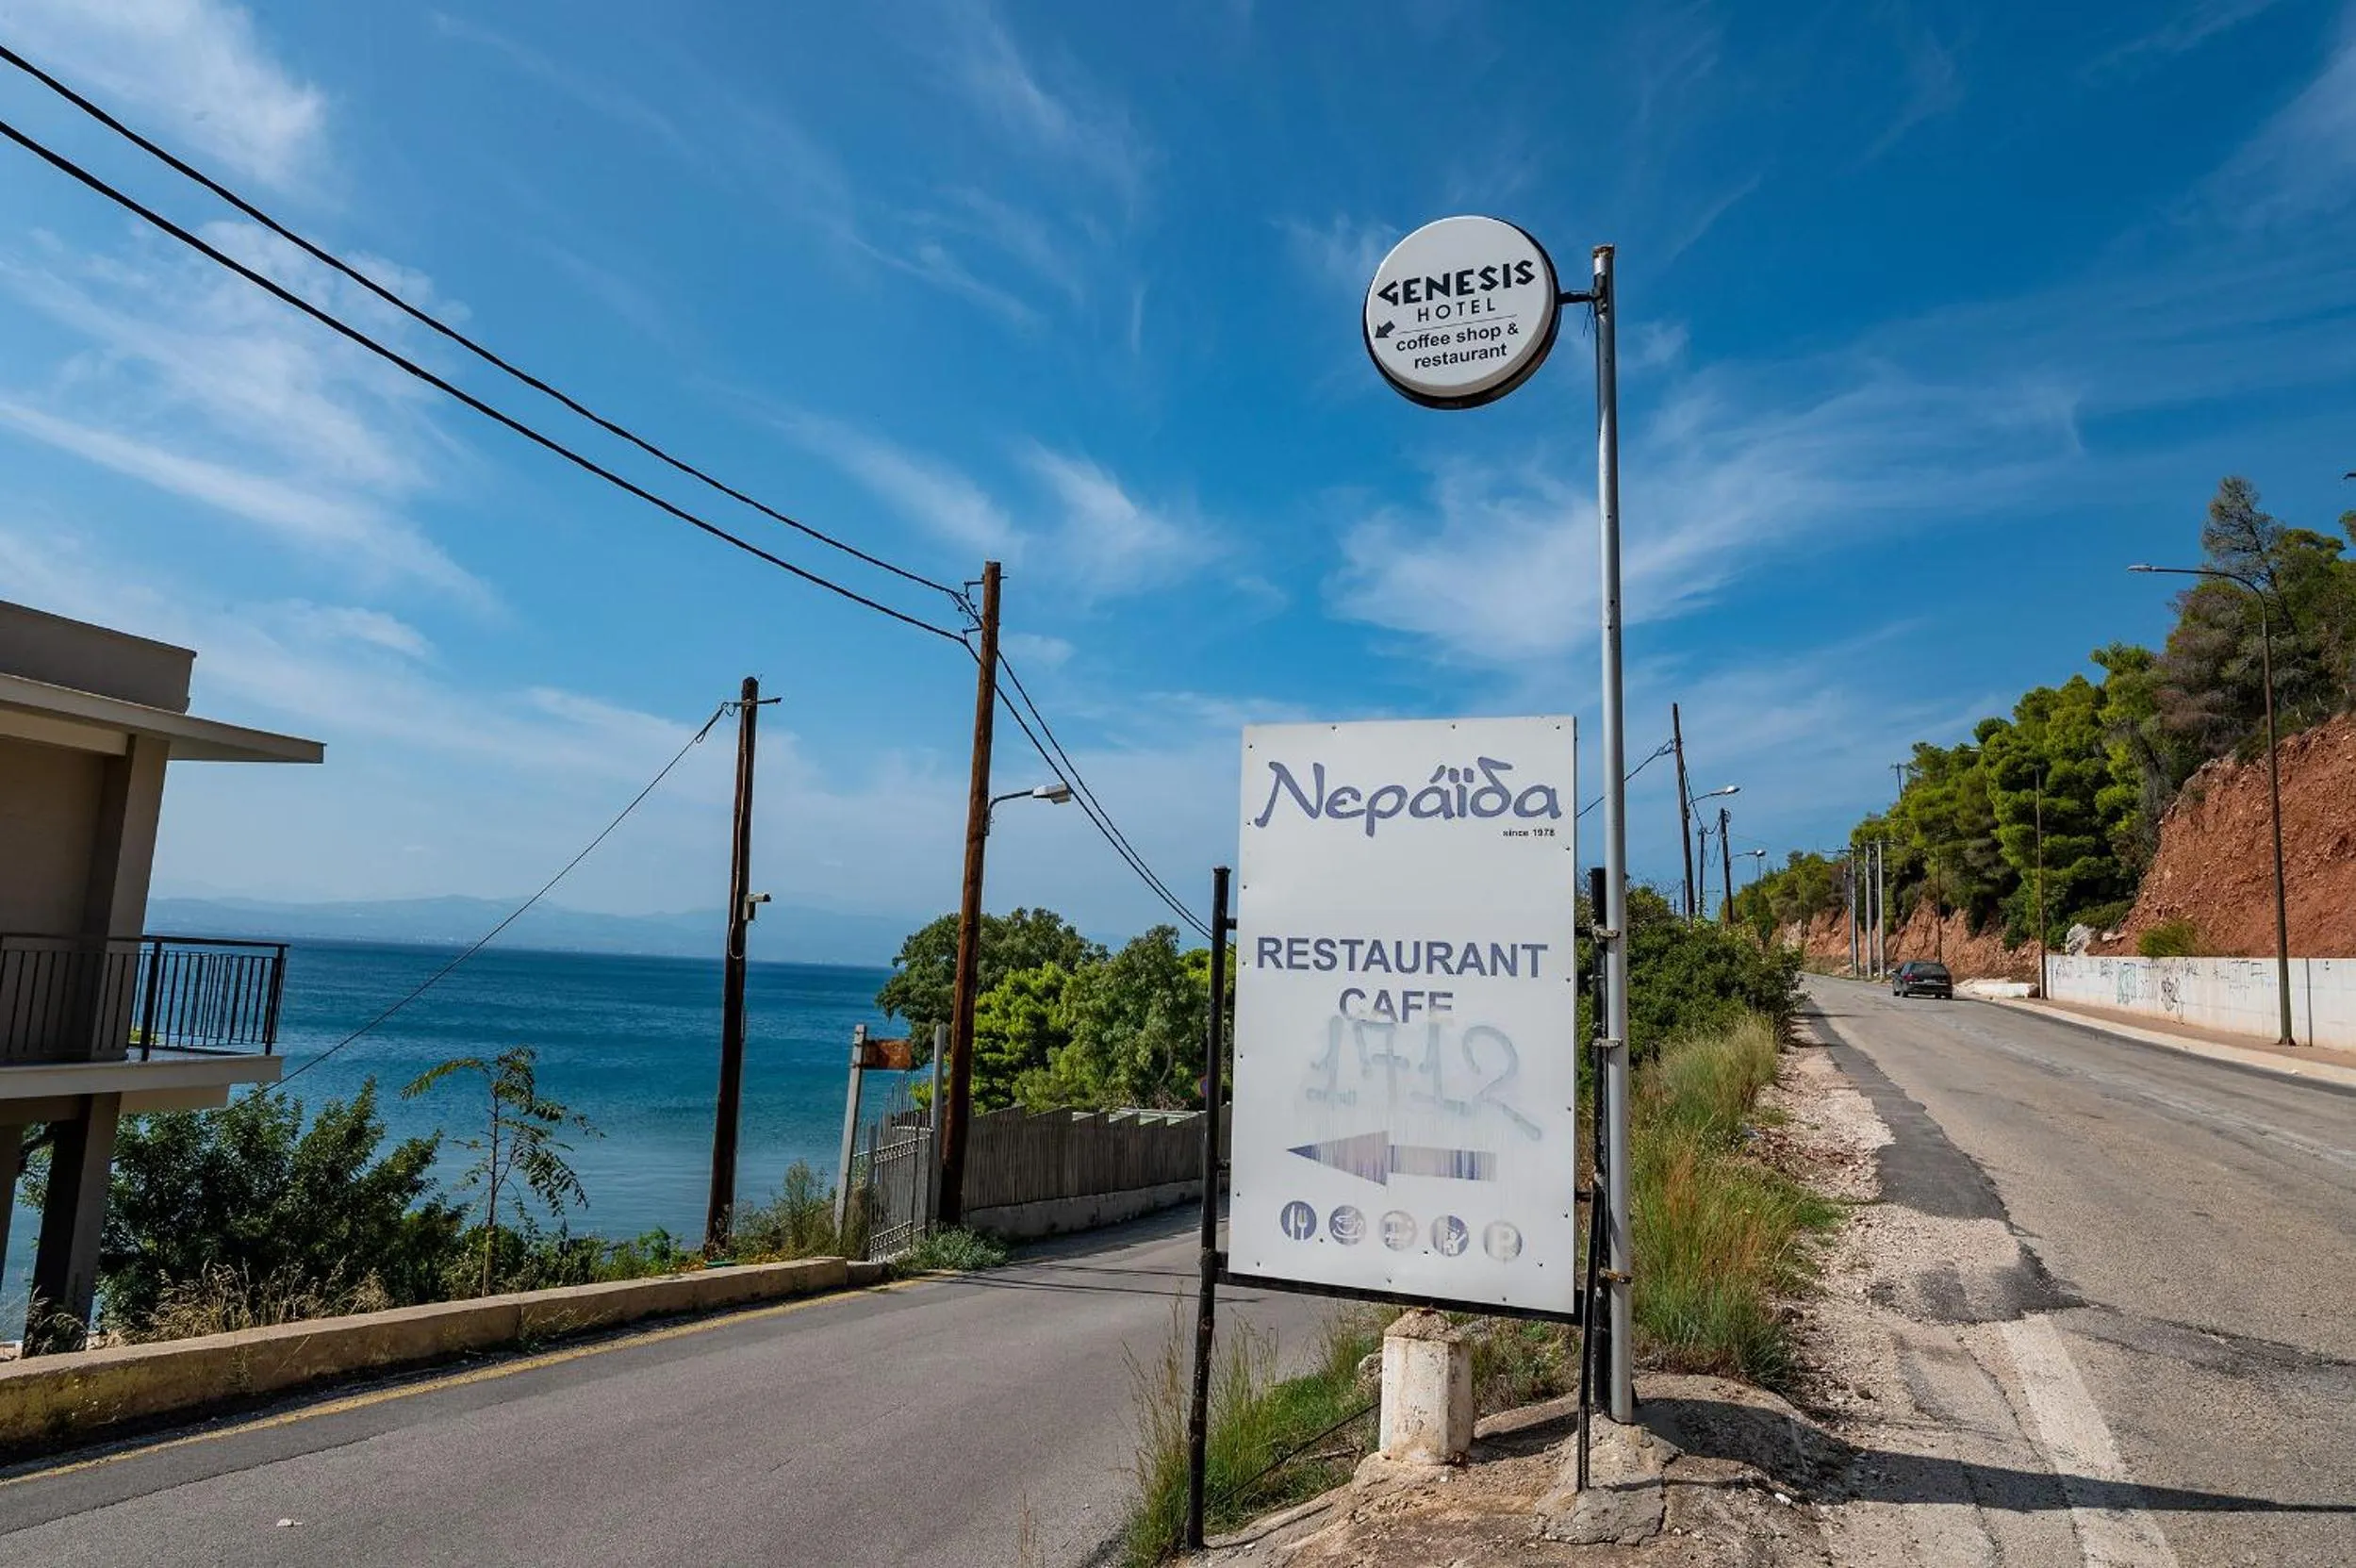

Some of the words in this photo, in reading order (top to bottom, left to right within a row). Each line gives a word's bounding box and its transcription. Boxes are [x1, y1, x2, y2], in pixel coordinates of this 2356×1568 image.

[1377, 260, 1535, 305] GENESIS
[1417, 298, 1495, 322] HOTEL
[1396, 333, 1451, 352] coffee
[1457, 325, 1501, 348] shop
[1508, 322, 1519, 336] &
[1414, 344, 1508, 369] restaurant
[1502, 829, 1529, 837] since
[1532, 828, 1556, 837] 1978
[1257, 936, 1548, 978] RESTAURANT
[1339, 988, 1454, 1023] CAFE
